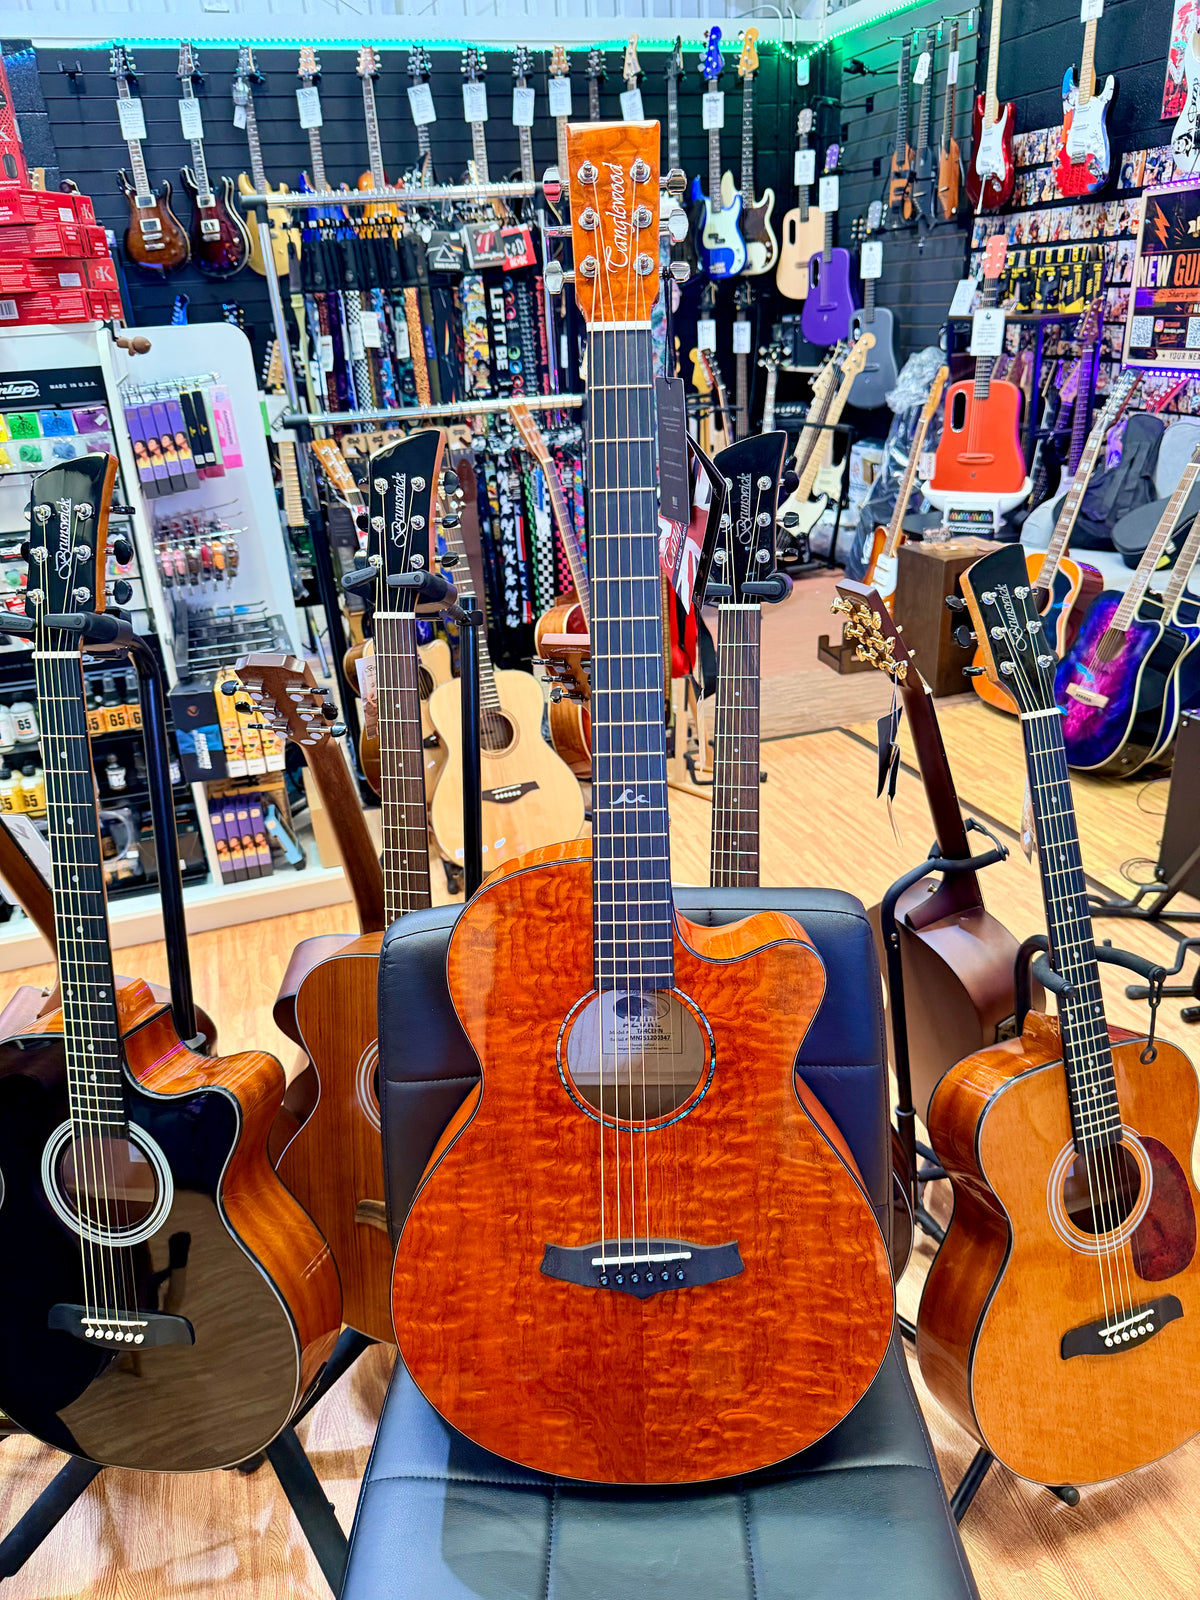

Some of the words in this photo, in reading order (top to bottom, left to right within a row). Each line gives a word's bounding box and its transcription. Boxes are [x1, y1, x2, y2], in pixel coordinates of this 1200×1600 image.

[601, 162, 635, 274] Tanglewood
[1135, 254, 1173, 288] NEW
[490, 287, 506, 322] LET
[493, 324, 507, 344] IT
[495, 345, 509, 371] BE
[391, 472, 407, 548] Brunswick
[736, 472, 752, 545] Brunswick
[54, 497, 73, 580] Brunswick
[993, 583, 1028, 652] Brunswick
[17, 718, 32, 730] 65
[109, 712, 126, 727] 65
